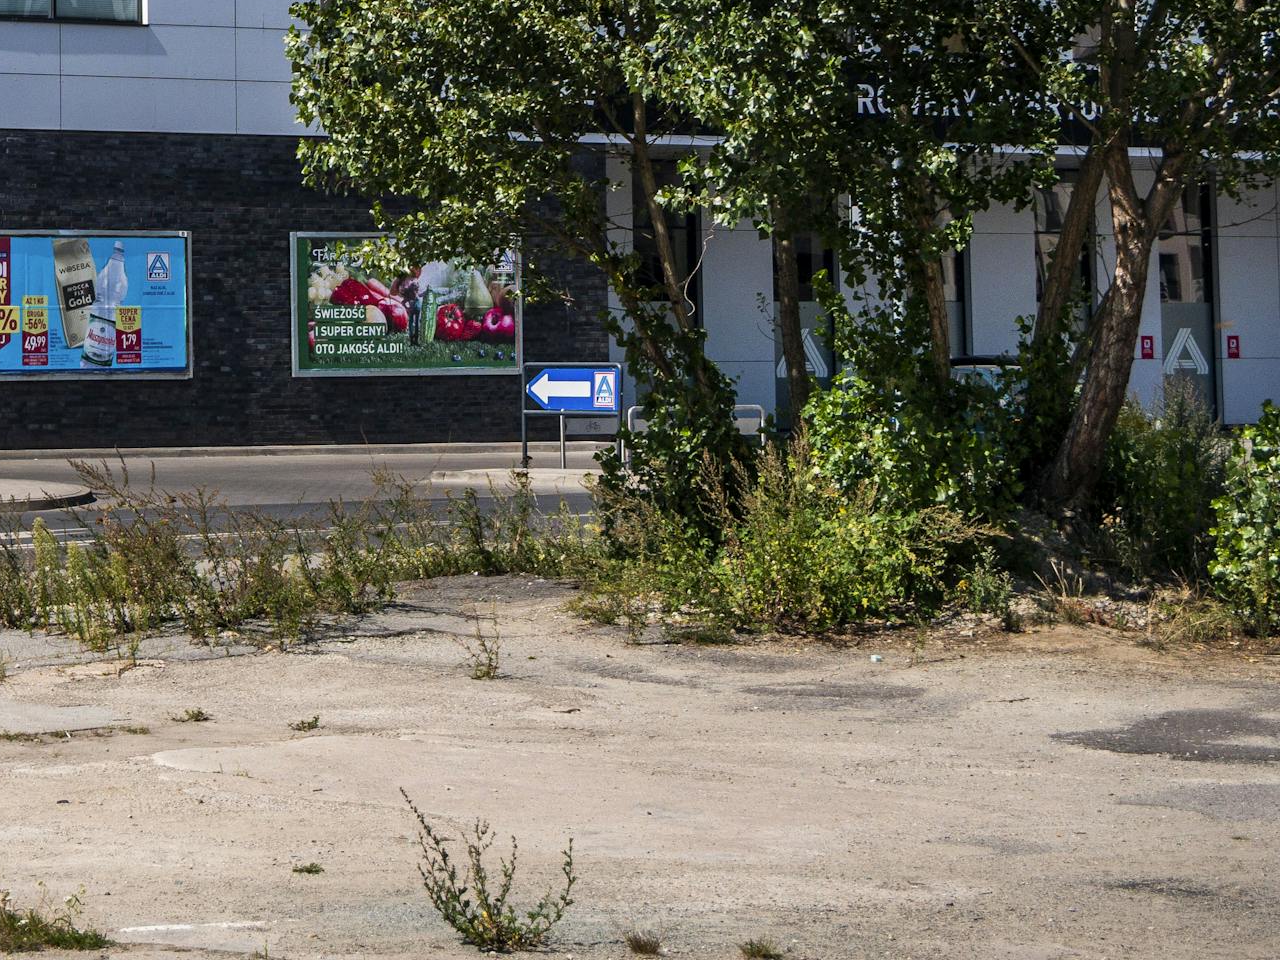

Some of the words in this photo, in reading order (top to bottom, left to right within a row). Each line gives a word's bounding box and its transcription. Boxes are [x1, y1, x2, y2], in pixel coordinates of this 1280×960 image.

[68, 294, 92, 308] Gold
[119, 308, 138, 316] SUPER
[314, 306, 365, 319] ŚWIEŻOŚĆ
[315, 326, 318, 336] I
[320, 325, 354, 337] SUPER
[356, 325, 385, 336] CENY!
[121, 333, 137, 350] 1.79
[315, 343, 335, 354] OTO
[336, 340, 375, 354] JAKOŚĆ
[377, 343, 403, 354] ALDI!
